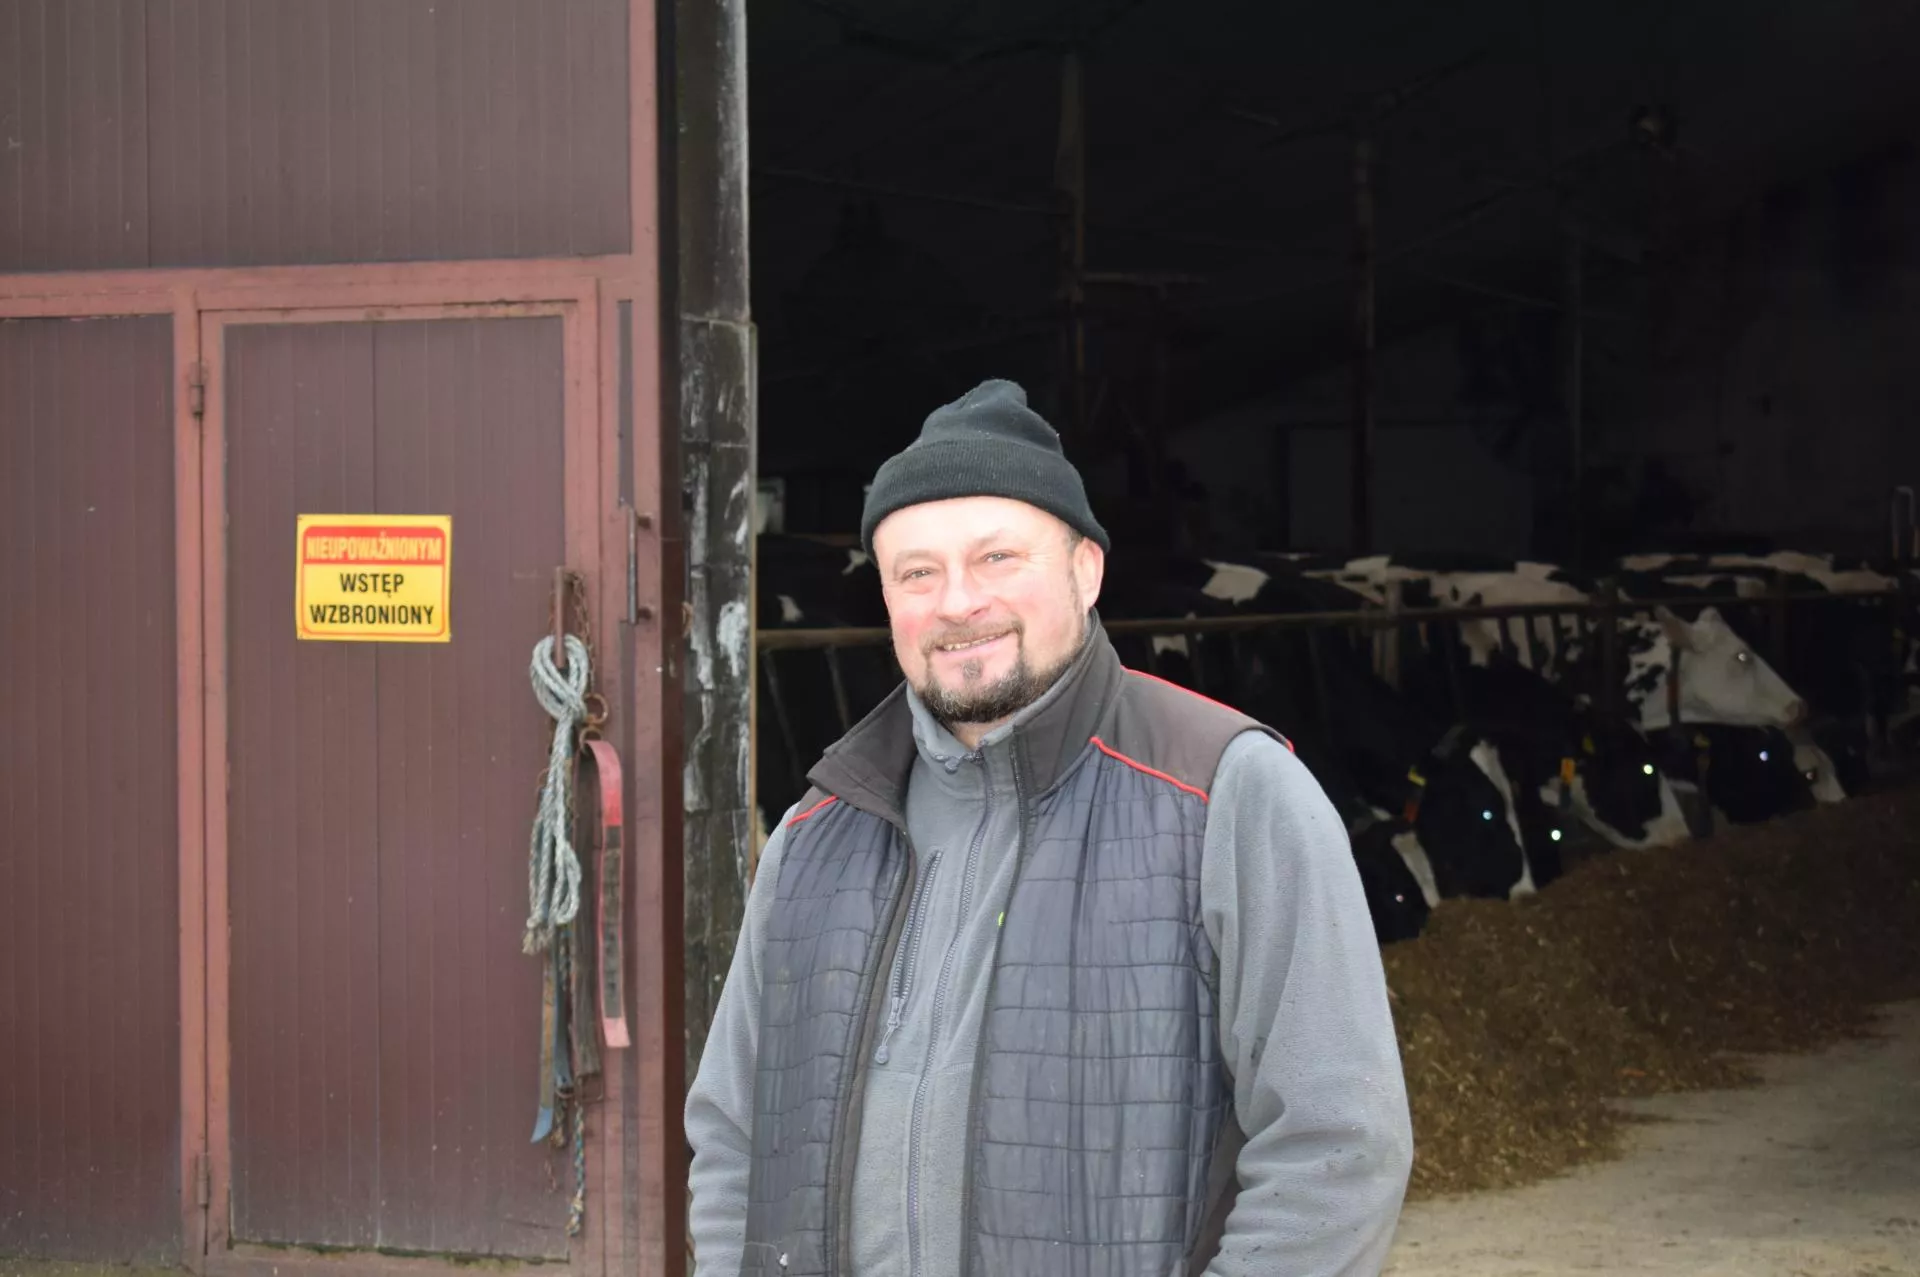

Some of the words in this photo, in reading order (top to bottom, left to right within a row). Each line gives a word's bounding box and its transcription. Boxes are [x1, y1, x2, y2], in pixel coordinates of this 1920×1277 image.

[306, 530, 442, 561] NIEUPOWAŻNIONYM
[340, 573, 404, 598] WSTĘP
[310, 604, 434, 625] WZBRONIONY
